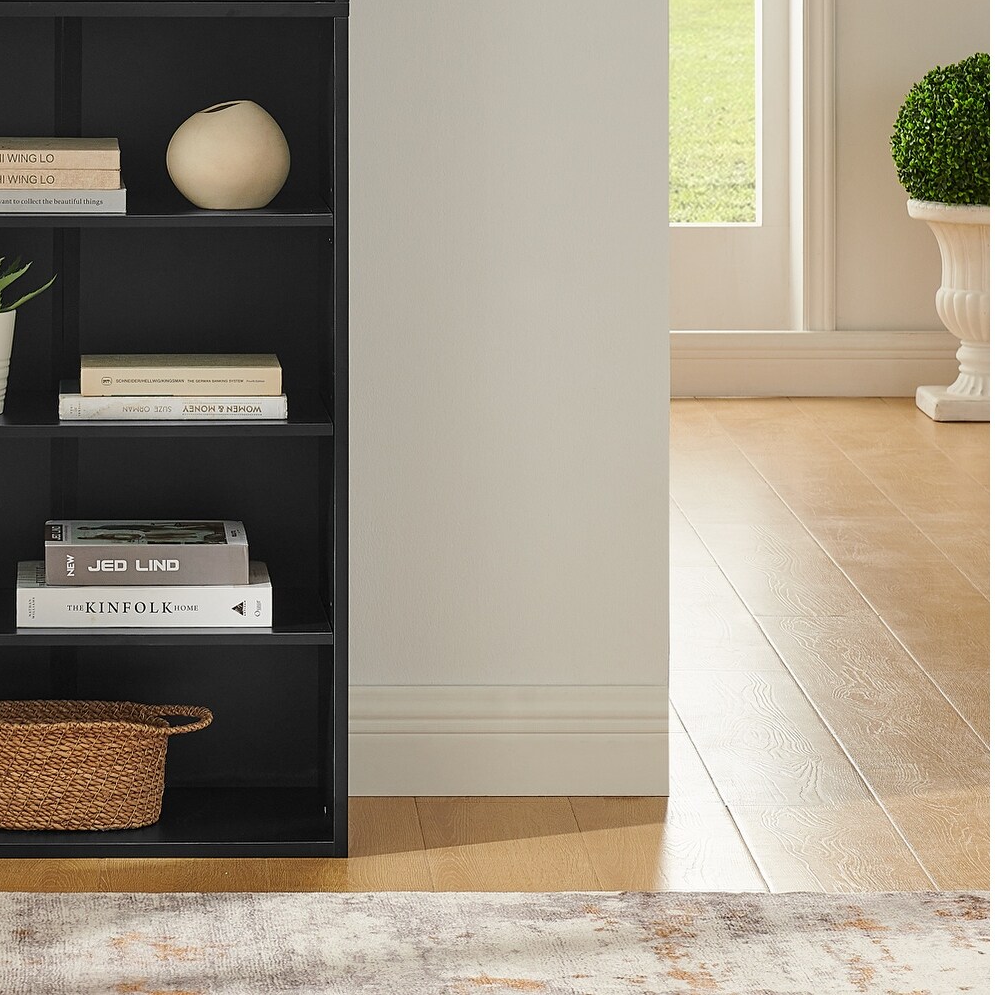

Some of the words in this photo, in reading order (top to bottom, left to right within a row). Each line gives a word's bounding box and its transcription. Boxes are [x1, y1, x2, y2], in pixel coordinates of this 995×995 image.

[6, 154, 37, 164] WING
[39, 154, 55, 164] LO
[7, 174, 38, 185] WING
[40, 174, 55, 185] LO
[12, 198, 20, 206] to
[20, 198, 42, 206] collect
[42, 198, 53, 206] the
[53, 198, 83, 206] beautiful
[83, 198, 104, 207] things
[122, 405, 151, 413] ORMAN
[153, 405, 172, 413] SUZE
[182, 405, 216, 413] MONEY
[218, 405, 225, 413] &
[226, 405, 262, 413] WOMEN
[66, 554, 76, 577] NEW
[87, 559, 127, 572] JED
[135, 559, 181, 572] LIND
[67, 604, 84, 612] THE
[85, 601, 174, 614] KINFOLK
